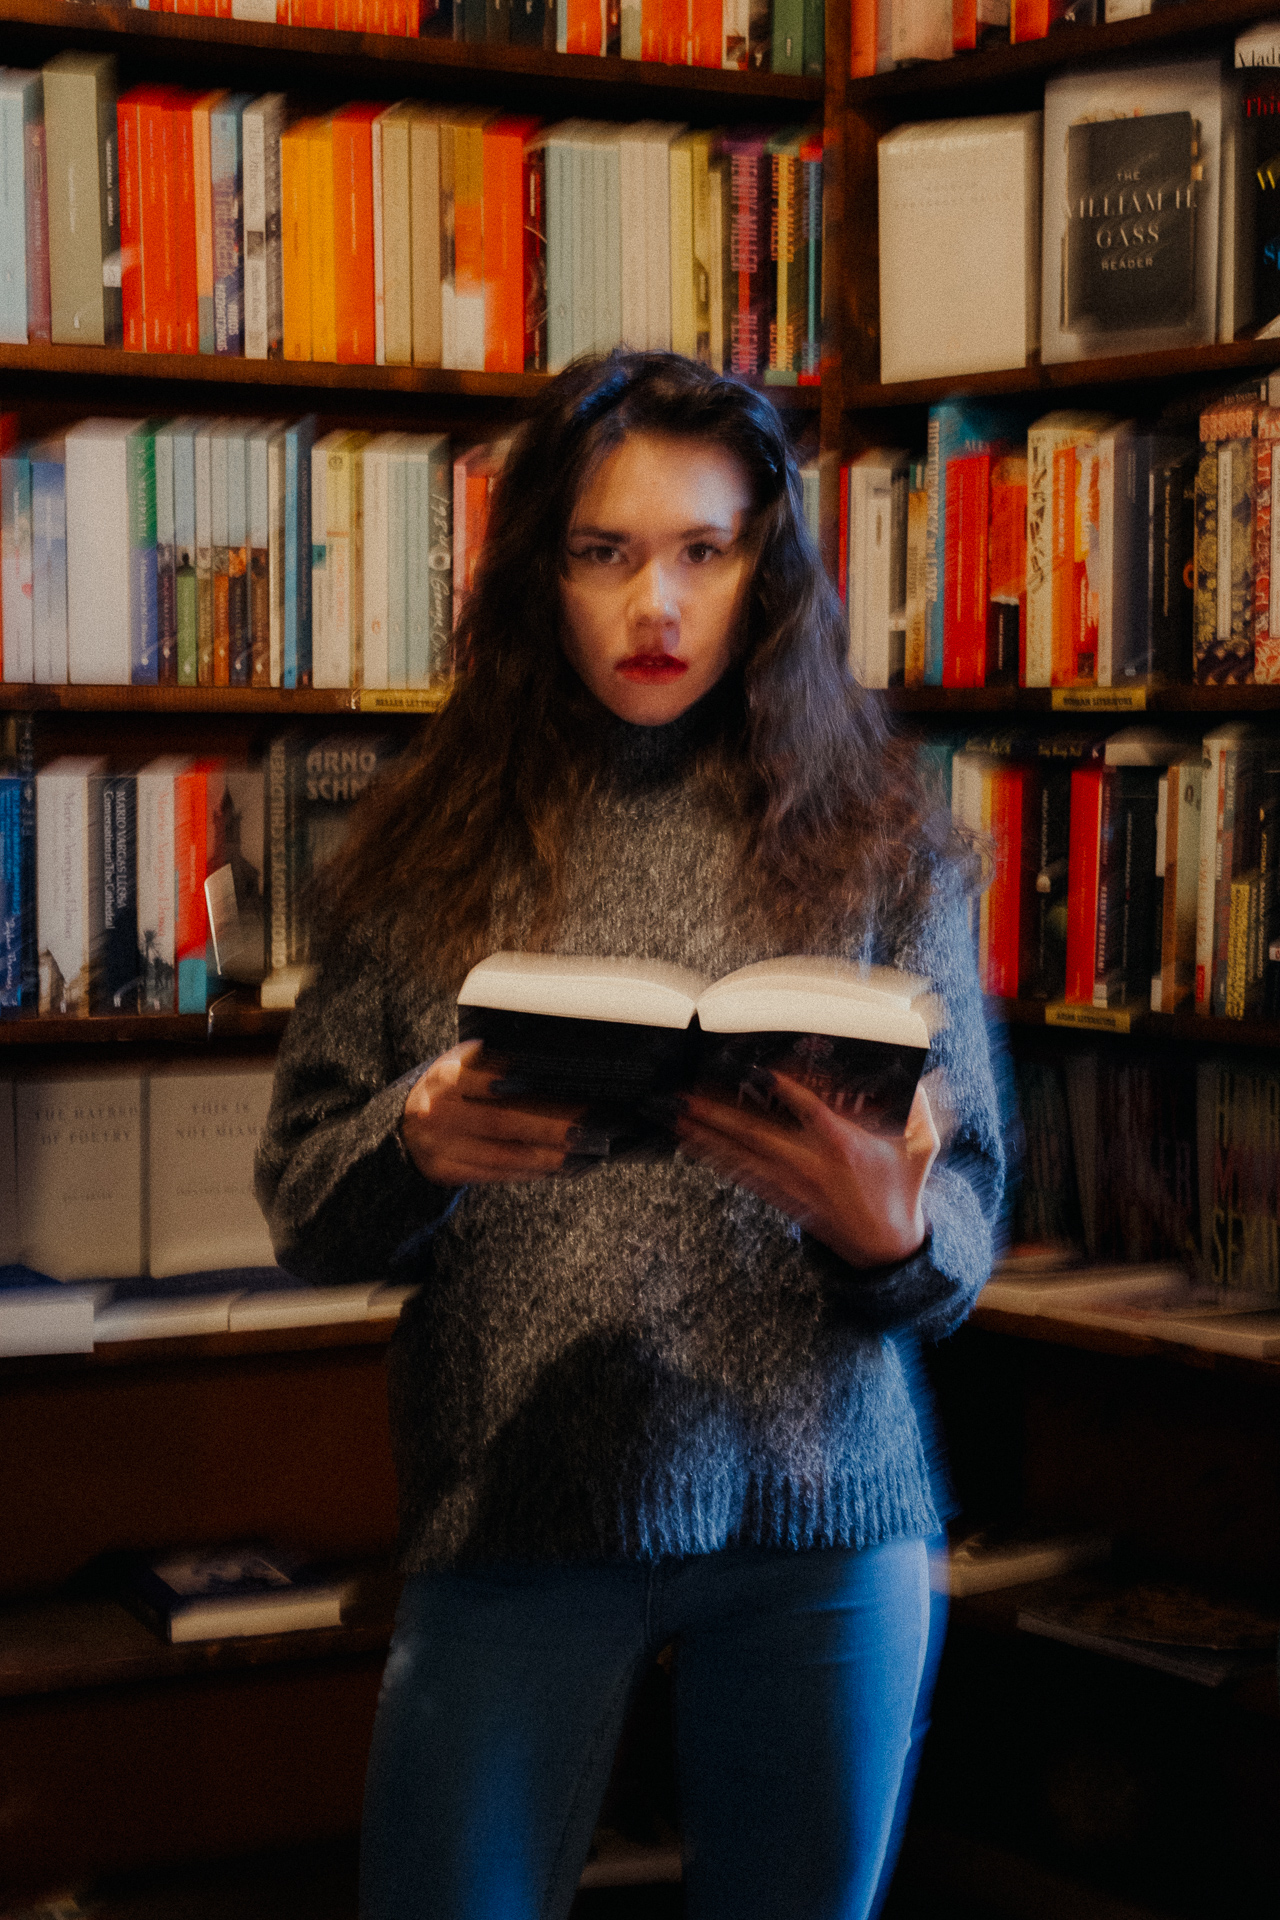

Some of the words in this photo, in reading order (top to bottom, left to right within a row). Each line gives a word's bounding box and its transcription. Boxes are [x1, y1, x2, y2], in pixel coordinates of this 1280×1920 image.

[732, 154, 757, 208] HENRY
[772, 153, 795, 201] HENRY
[1117, 170, 1141, 182] THE
[732, 214, 757, 273] MILLER
[771, 206, 795, 263] MILLER
[1095, 223, 1160, 249] GASS
[1101, 256, 1154, 271] READER
[731, 313, 758, 374] PLEXUS
[430, 577, 451, 628] George
[307, 750, 376, 775] ARNO
[104, 790, 116, 857] Conversation
[115, 790, 128, 828] MARIO
[115, 829, 128, 873] VARGAS
[104, 883, 117, 930] Cathedral
